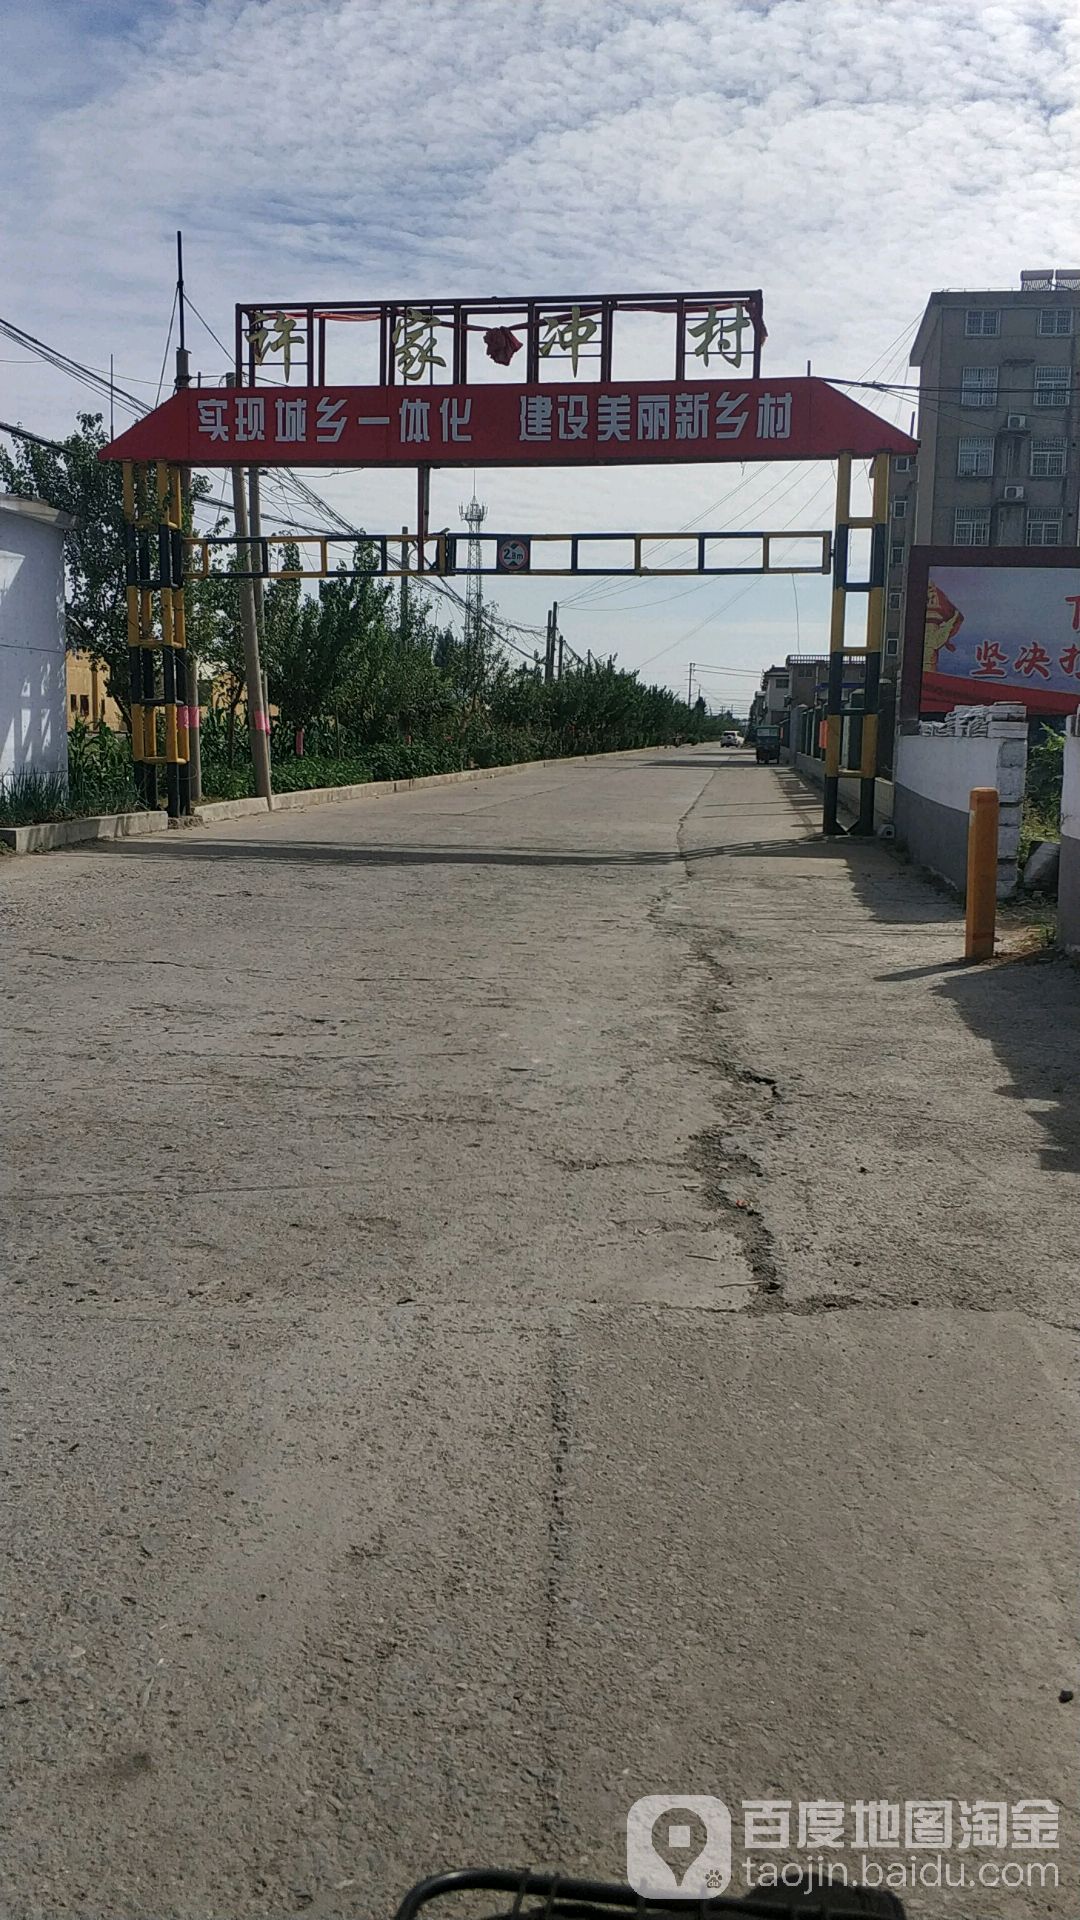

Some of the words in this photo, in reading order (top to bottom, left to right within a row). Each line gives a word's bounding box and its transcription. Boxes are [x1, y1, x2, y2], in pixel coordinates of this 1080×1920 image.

[197, 396, 473, 443] 实现城乡一体化
[518, 391, 793, 442] 建设美丽新乡村
